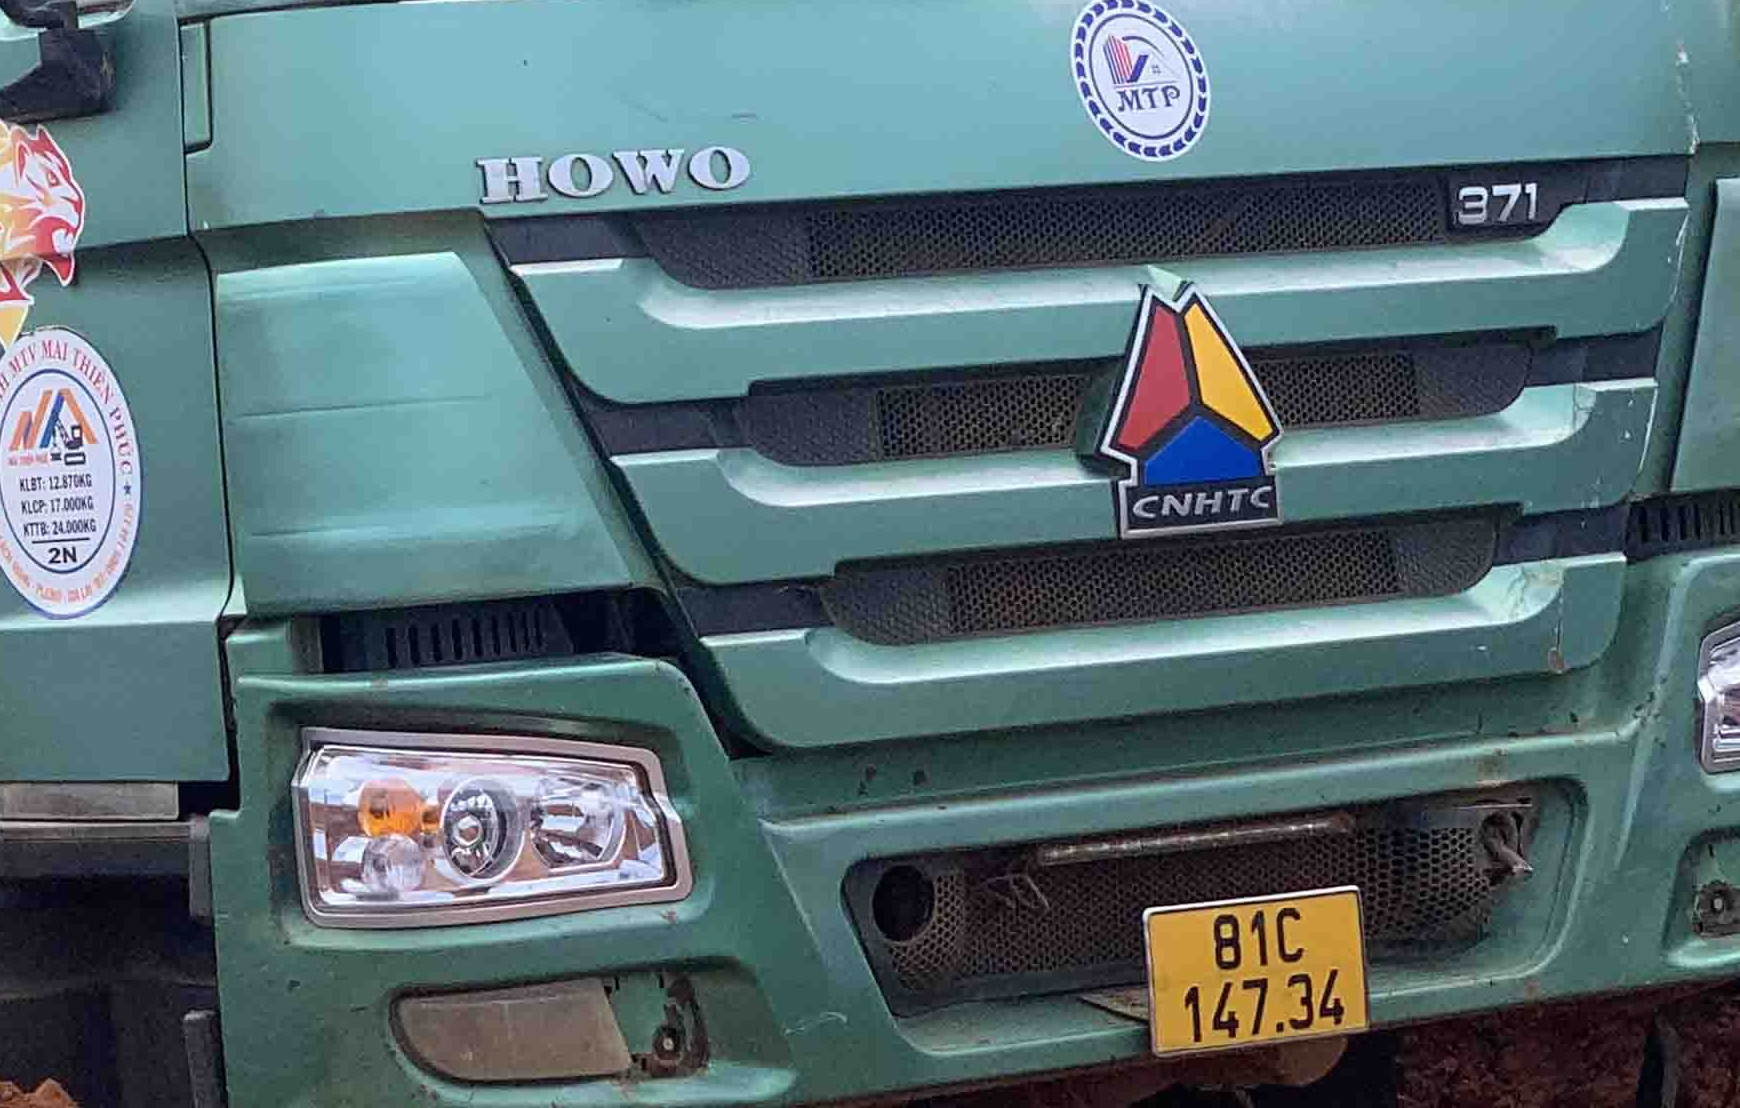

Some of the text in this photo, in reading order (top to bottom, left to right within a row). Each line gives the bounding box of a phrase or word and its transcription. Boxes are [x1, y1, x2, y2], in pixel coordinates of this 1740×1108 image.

[1116, 85, 1181, 112] MTP
[475, 146, 751, 205] HOWO
[1458, 182, 1538, 225] 371
[10, 342, 37, 376] MTV
[41, 339, 68, 361] MAI
[19, 473, 92, 492] KLBT: 12.870KG
[20, 495, 94, 515] KLCP: 17.000KG
[1132, 485, 1273, 519] CNHTC
[23, 518, 97, 538] KTTB: 24.000KG
[47, 546, 78, 564] 2N
[1213, 907, 1306, 971] 81C
[1183, 968, 1345, 1043] 147.34
